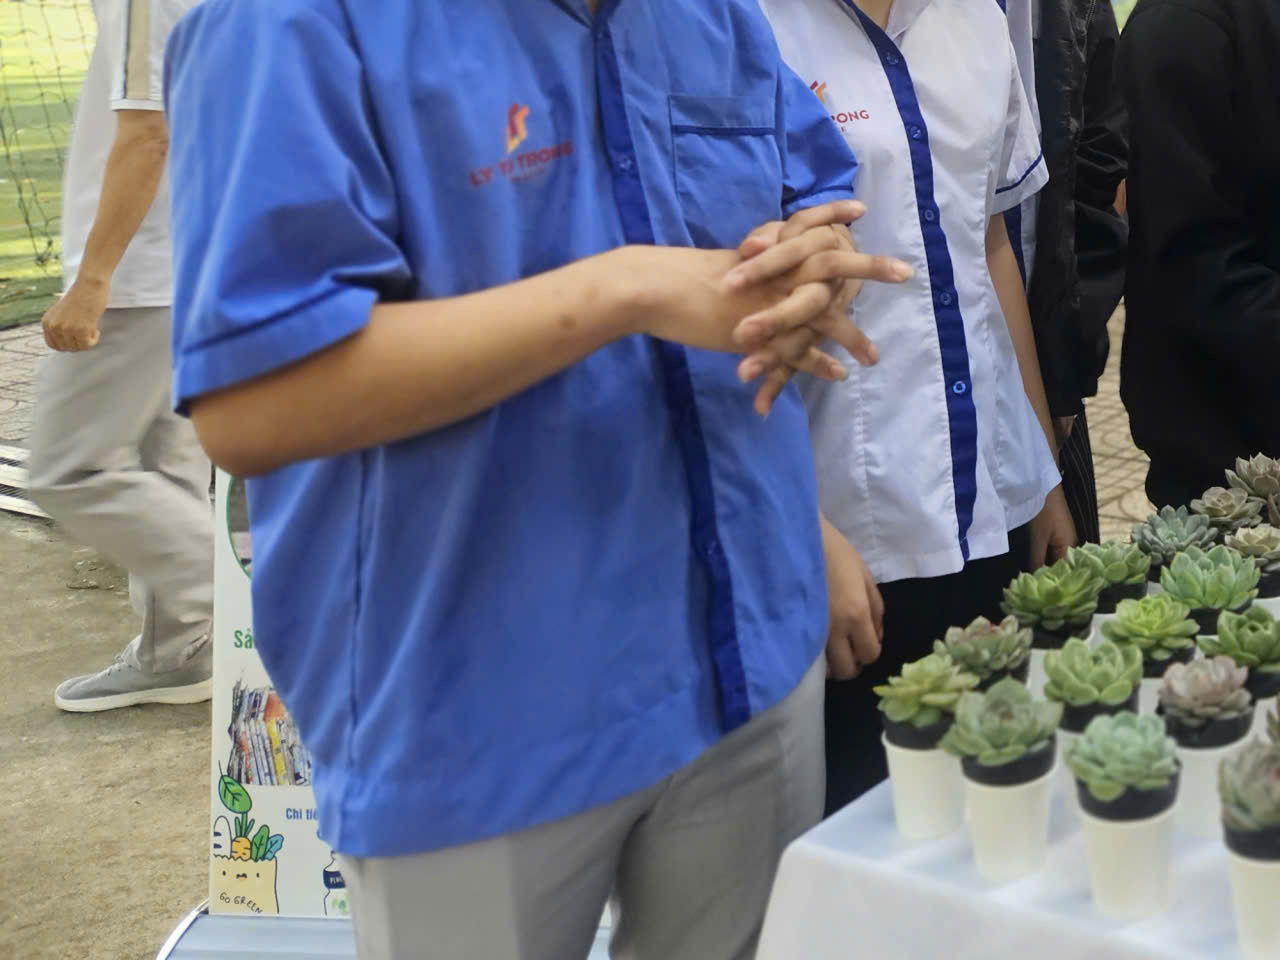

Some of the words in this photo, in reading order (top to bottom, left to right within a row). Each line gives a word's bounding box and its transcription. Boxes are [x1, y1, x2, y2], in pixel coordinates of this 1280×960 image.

[285, 807, 303, 820] Chi
[219, 891, 231, 904] GO
[233, 895, 263, 914] GREEN
